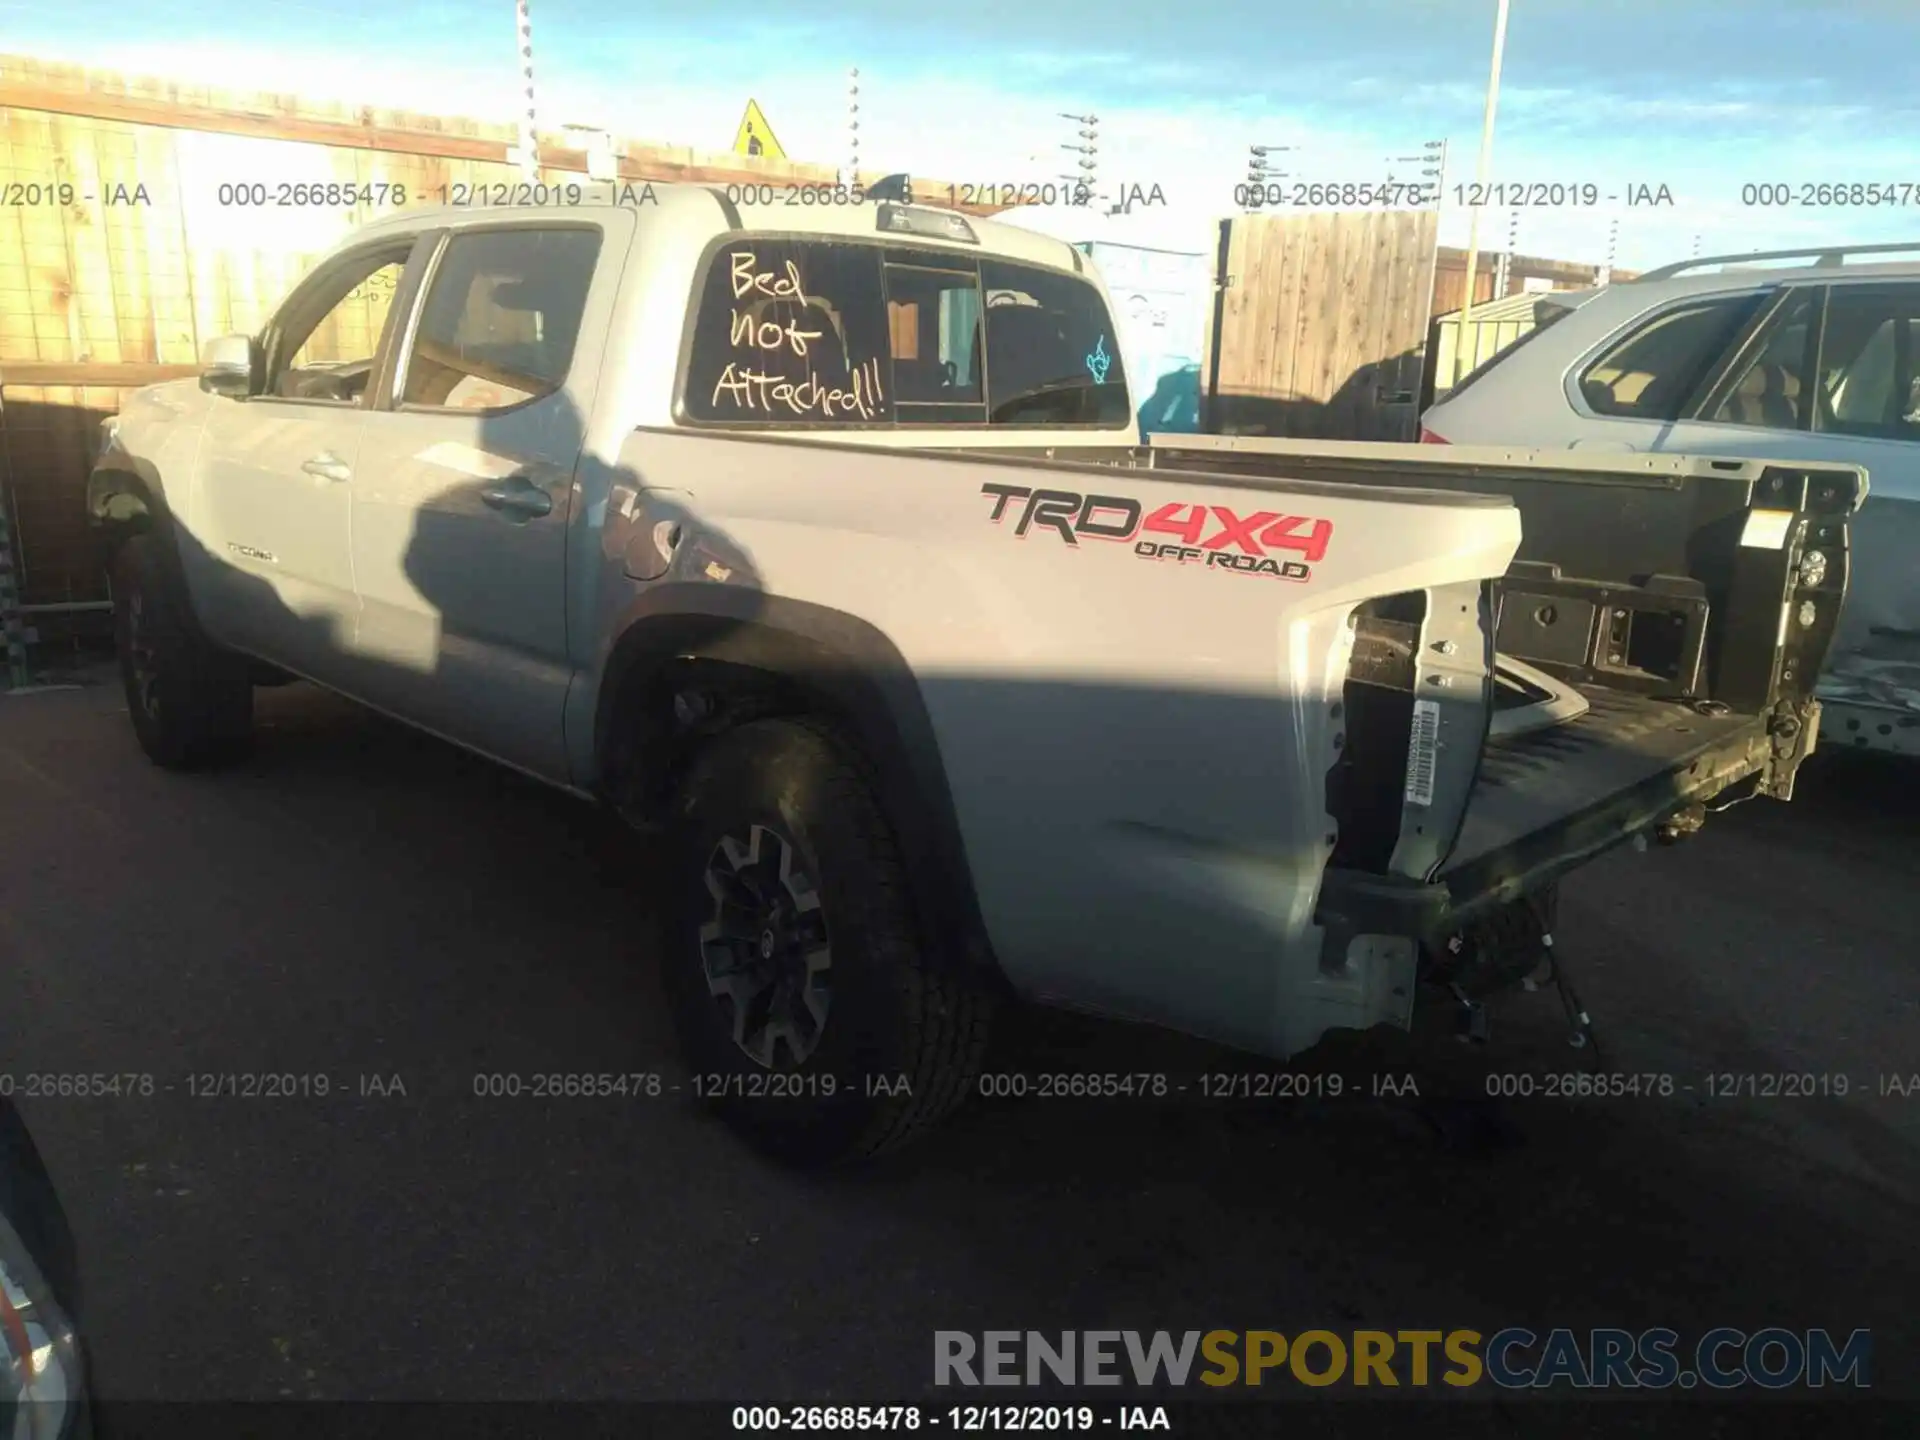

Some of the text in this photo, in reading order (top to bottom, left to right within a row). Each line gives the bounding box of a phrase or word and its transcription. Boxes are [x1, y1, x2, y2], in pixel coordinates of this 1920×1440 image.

[731, 253, 808, 307] Bed
[980, 482, 1142, 548] TRD
[1134, 540, 1312, 582] OFF ROAD
